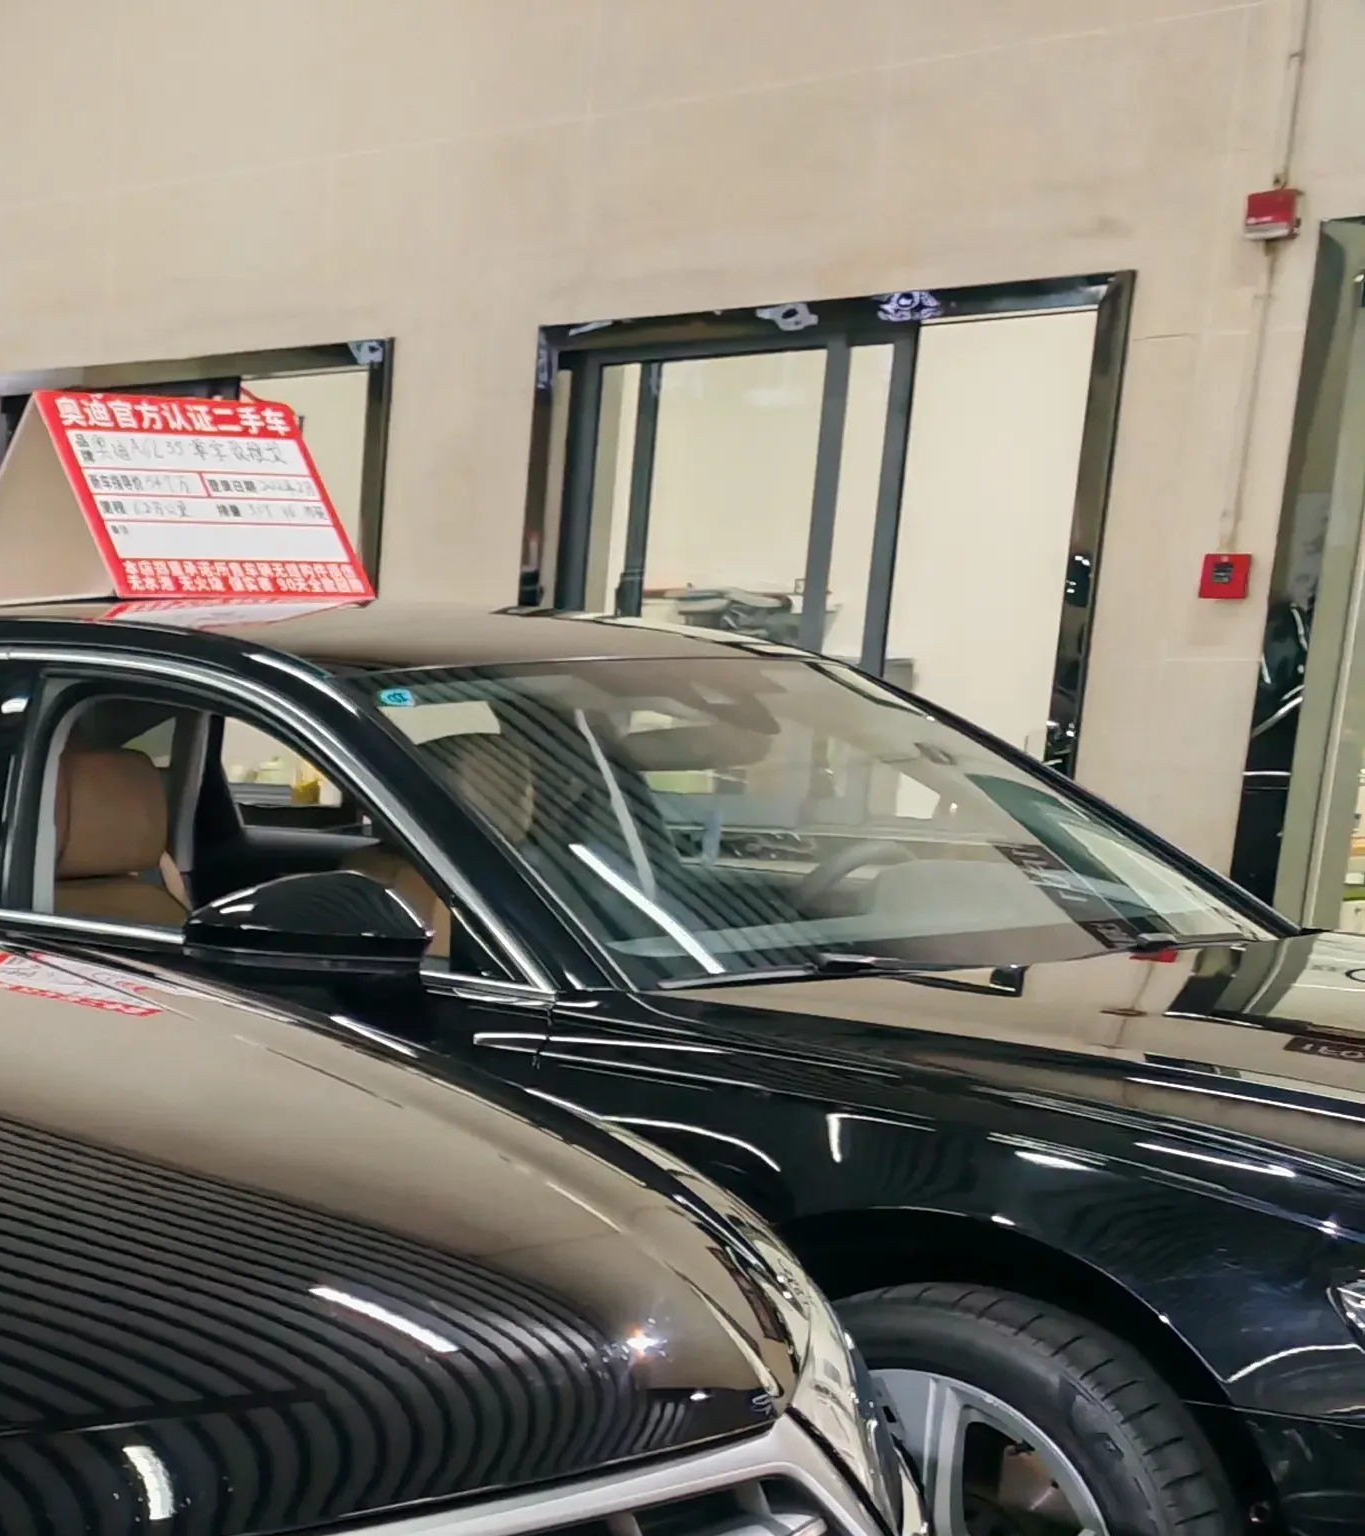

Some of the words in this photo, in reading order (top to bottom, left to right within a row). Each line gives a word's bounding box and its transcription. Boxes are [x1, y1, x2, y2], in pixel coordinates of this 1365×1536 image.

[55, 396, 291, 436] 奥迪官方认证二手车
